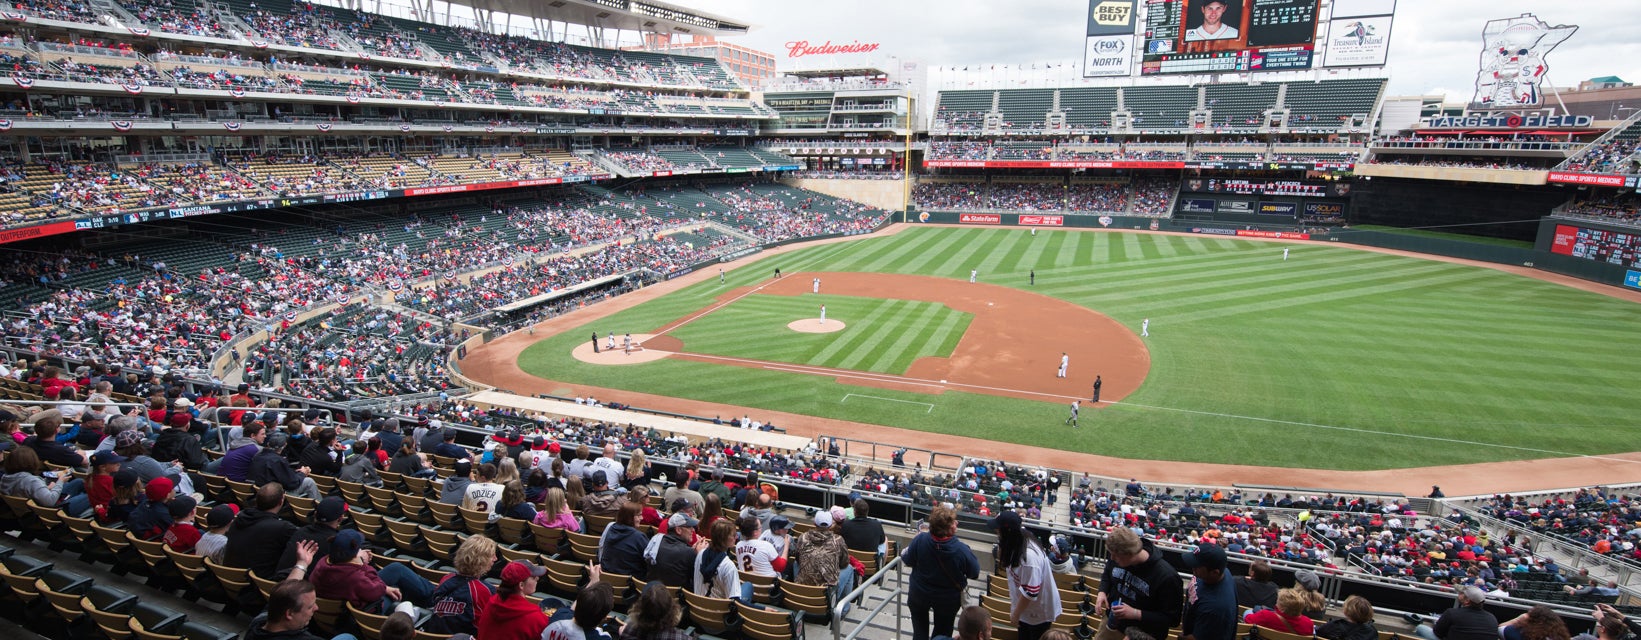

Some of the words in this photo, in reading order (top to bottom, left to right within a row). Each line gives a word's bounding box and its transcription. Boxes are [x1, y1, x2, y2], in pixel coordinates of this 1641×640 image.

[1099, 6, 1130, 14] BEST
[1100, 40, 1118, 49] FOX
[1334, 38, 1358, 46] Treasure
[1364, 36, 1383, 44] Island
[784, 40, 880, 57] Budweiser
[1092, 58, 1123, 67] NORTH
[1429, 115, 1505, 127] TARGET
[1525, 115, 1592, 127] FIELD
[1597, 177, 1622, 185] MEDICINE
[1628, 275, 1638, 283] BE
[472, 489, 497, 500] DOZIER
[476, 501, 488, 512] 2
[738, 546, 757, 555] DOZIER
[743, 555, 754, 572] 2
